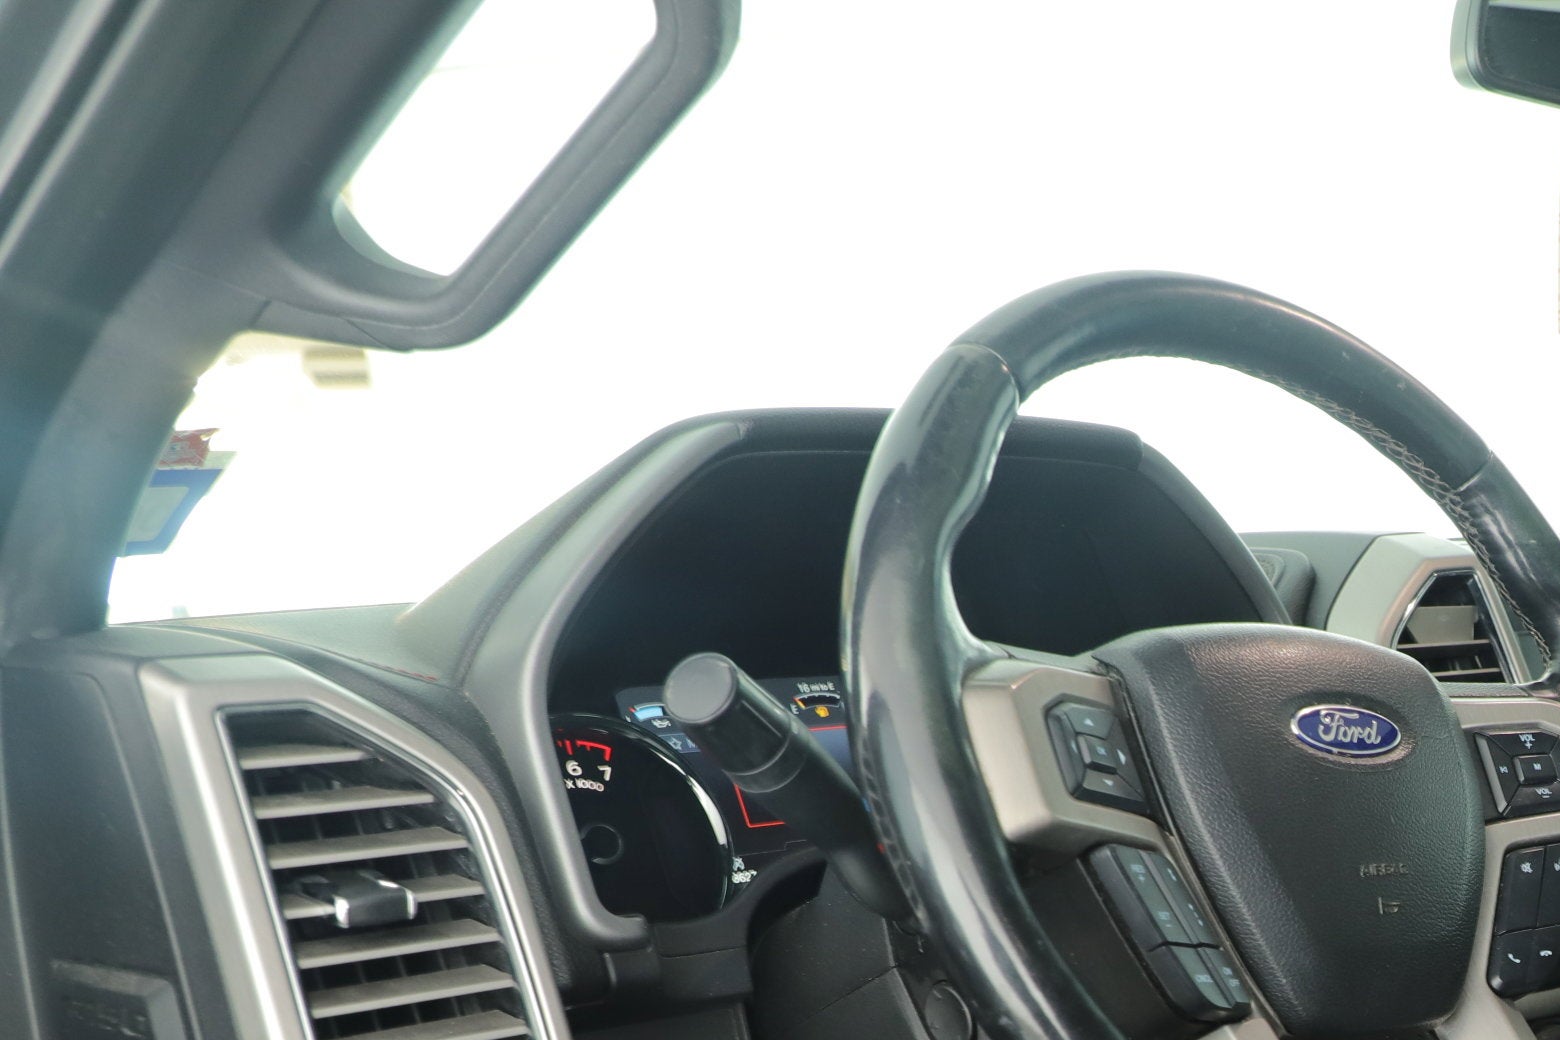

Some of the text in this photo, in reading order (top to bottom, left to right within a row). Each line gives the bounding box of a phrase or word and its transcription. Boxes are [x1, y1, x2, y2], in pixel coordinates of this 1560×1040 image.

[1318, 709, 1382, 745] Ford
[1519, 733, 1536, 742] VOL
[565, 760, 583, 777] 6
[597, 764, 612, 782] 7
[575, 777, 605, 793] 1000
[1535, 787, 1553, 795] VOL
